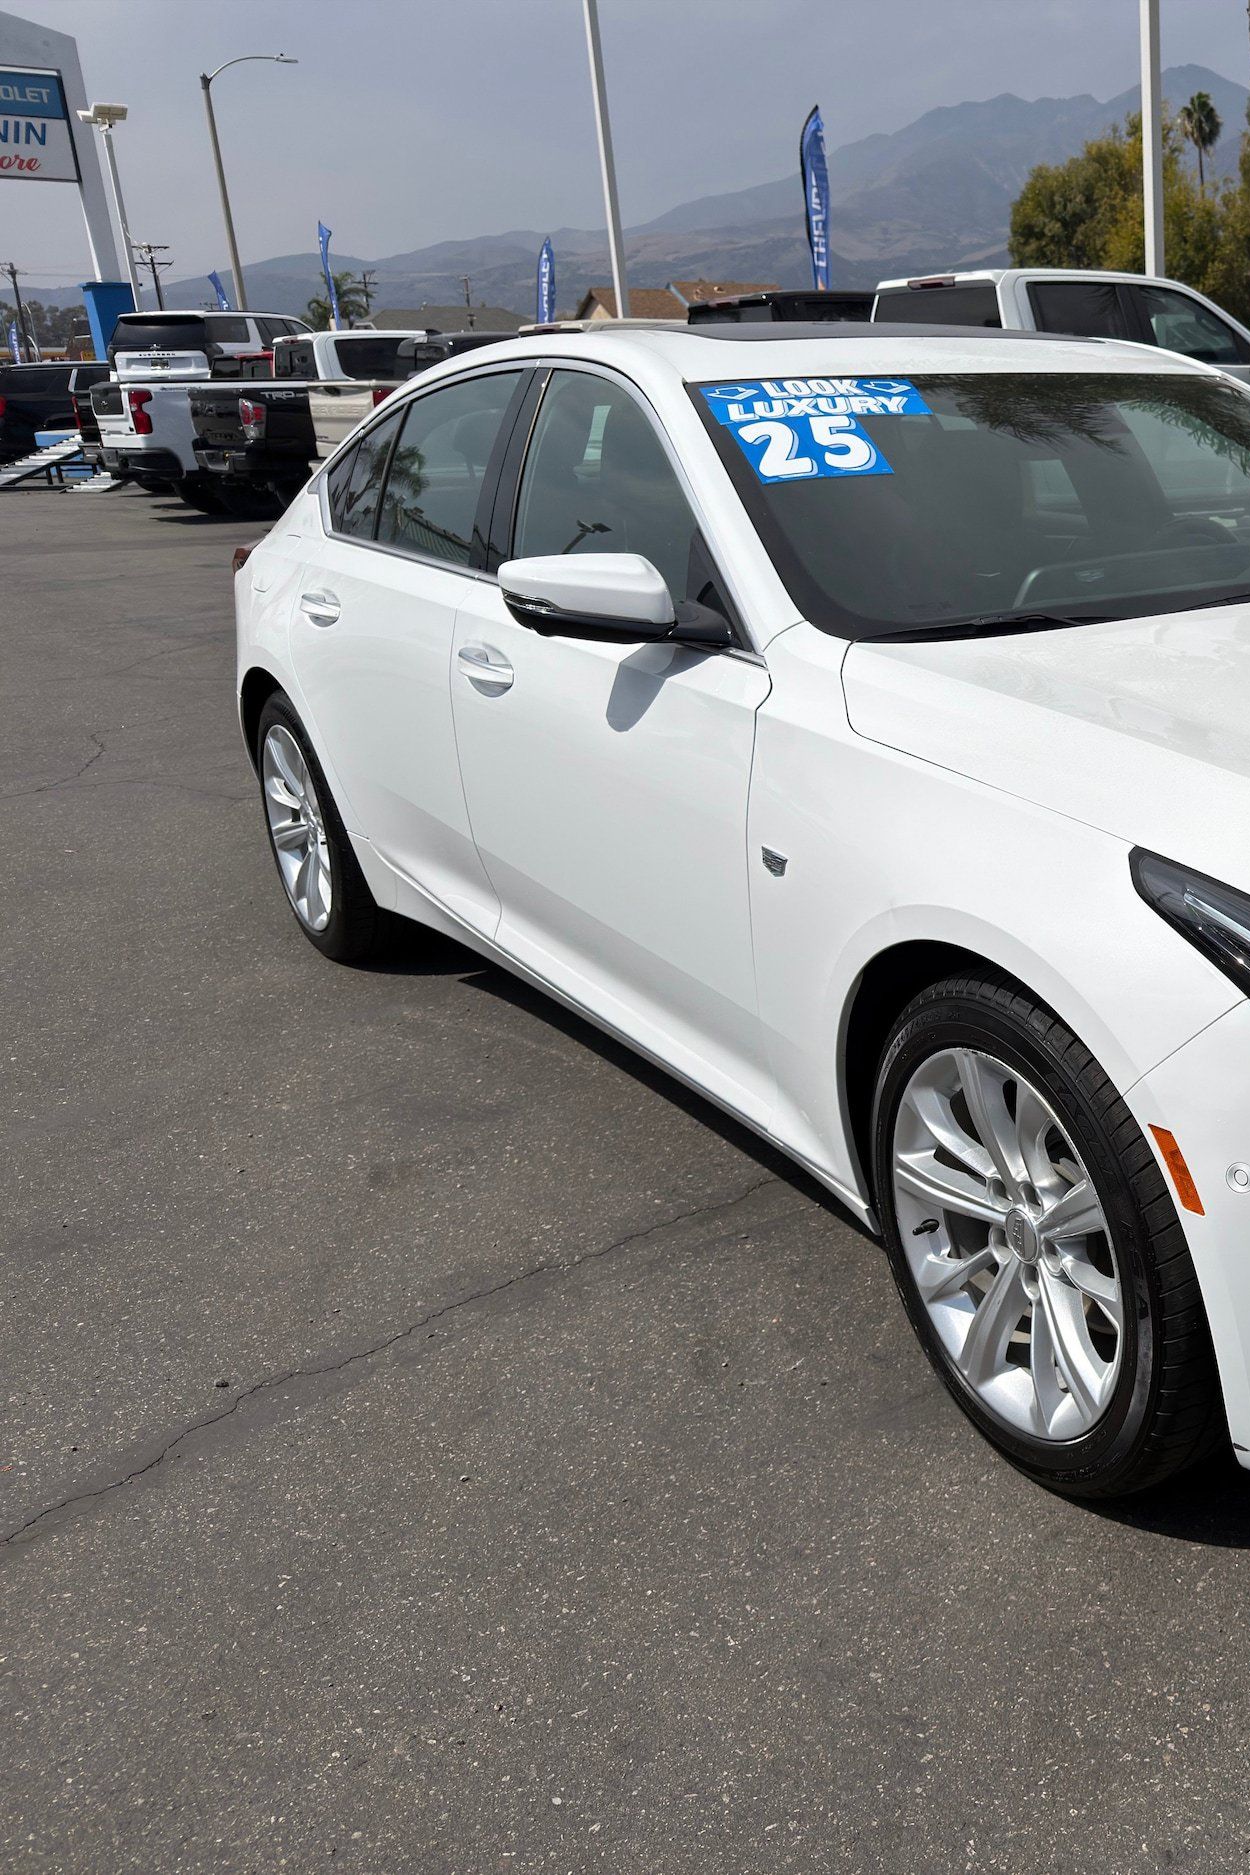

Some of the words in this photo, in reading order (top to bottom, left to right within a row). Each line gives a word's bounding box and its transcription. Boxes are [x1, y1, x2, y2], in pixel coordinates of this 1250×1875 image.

[260, 391, 295, 401] TRD
[759, 379, 869, 399] LOOK
[726, 395, 909, 423] LUXURY
[738, 415, 877, 479] 25
